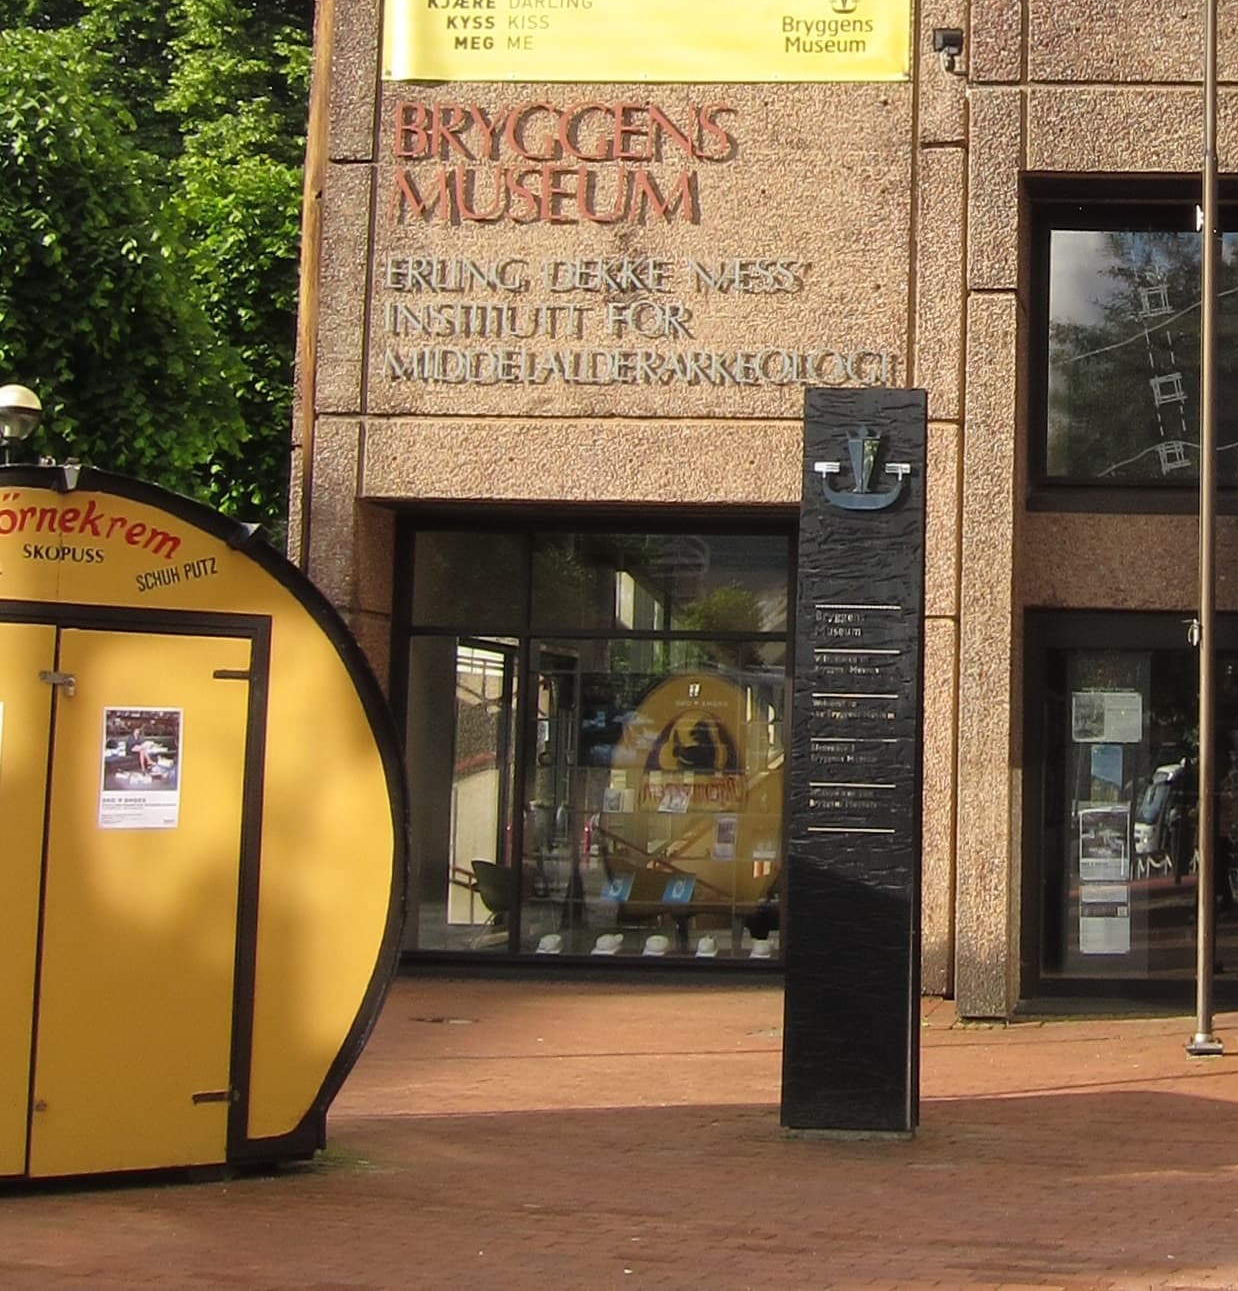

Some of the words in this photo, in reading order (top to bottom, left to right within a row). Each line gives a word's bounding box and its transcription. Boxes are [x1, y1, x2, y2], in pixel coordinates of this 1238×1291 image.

[446, 16, 495, 30] KYSS
[508, 15, 550, 29] KISS
[782, 15, 874, 37] Bryggens
[454, 36, 495, 50] MEG
[507, 35, 534, 50] ME
[785, 36, 866, 53] Museum
[393, 101, 730, 161] BRYGGENS
[388, 164, 695, 221] MUSEUM
[384, 256, 522, 292] ERLING
[543, 257, 667, 292] DEKKE
[688, 257, 796, 292] NÆSS
[383, 302, 586, 336] INSTITUTT
[607, 302, 688, 336] FOR
[383, 348, 890, 385] MIDDELALDERARKEOLOGI
[23, 543, 105, 563] SKOPUSS
[136, 564, 181, 592] SCHUH
[184, 557, 218, 580] PUTZ
